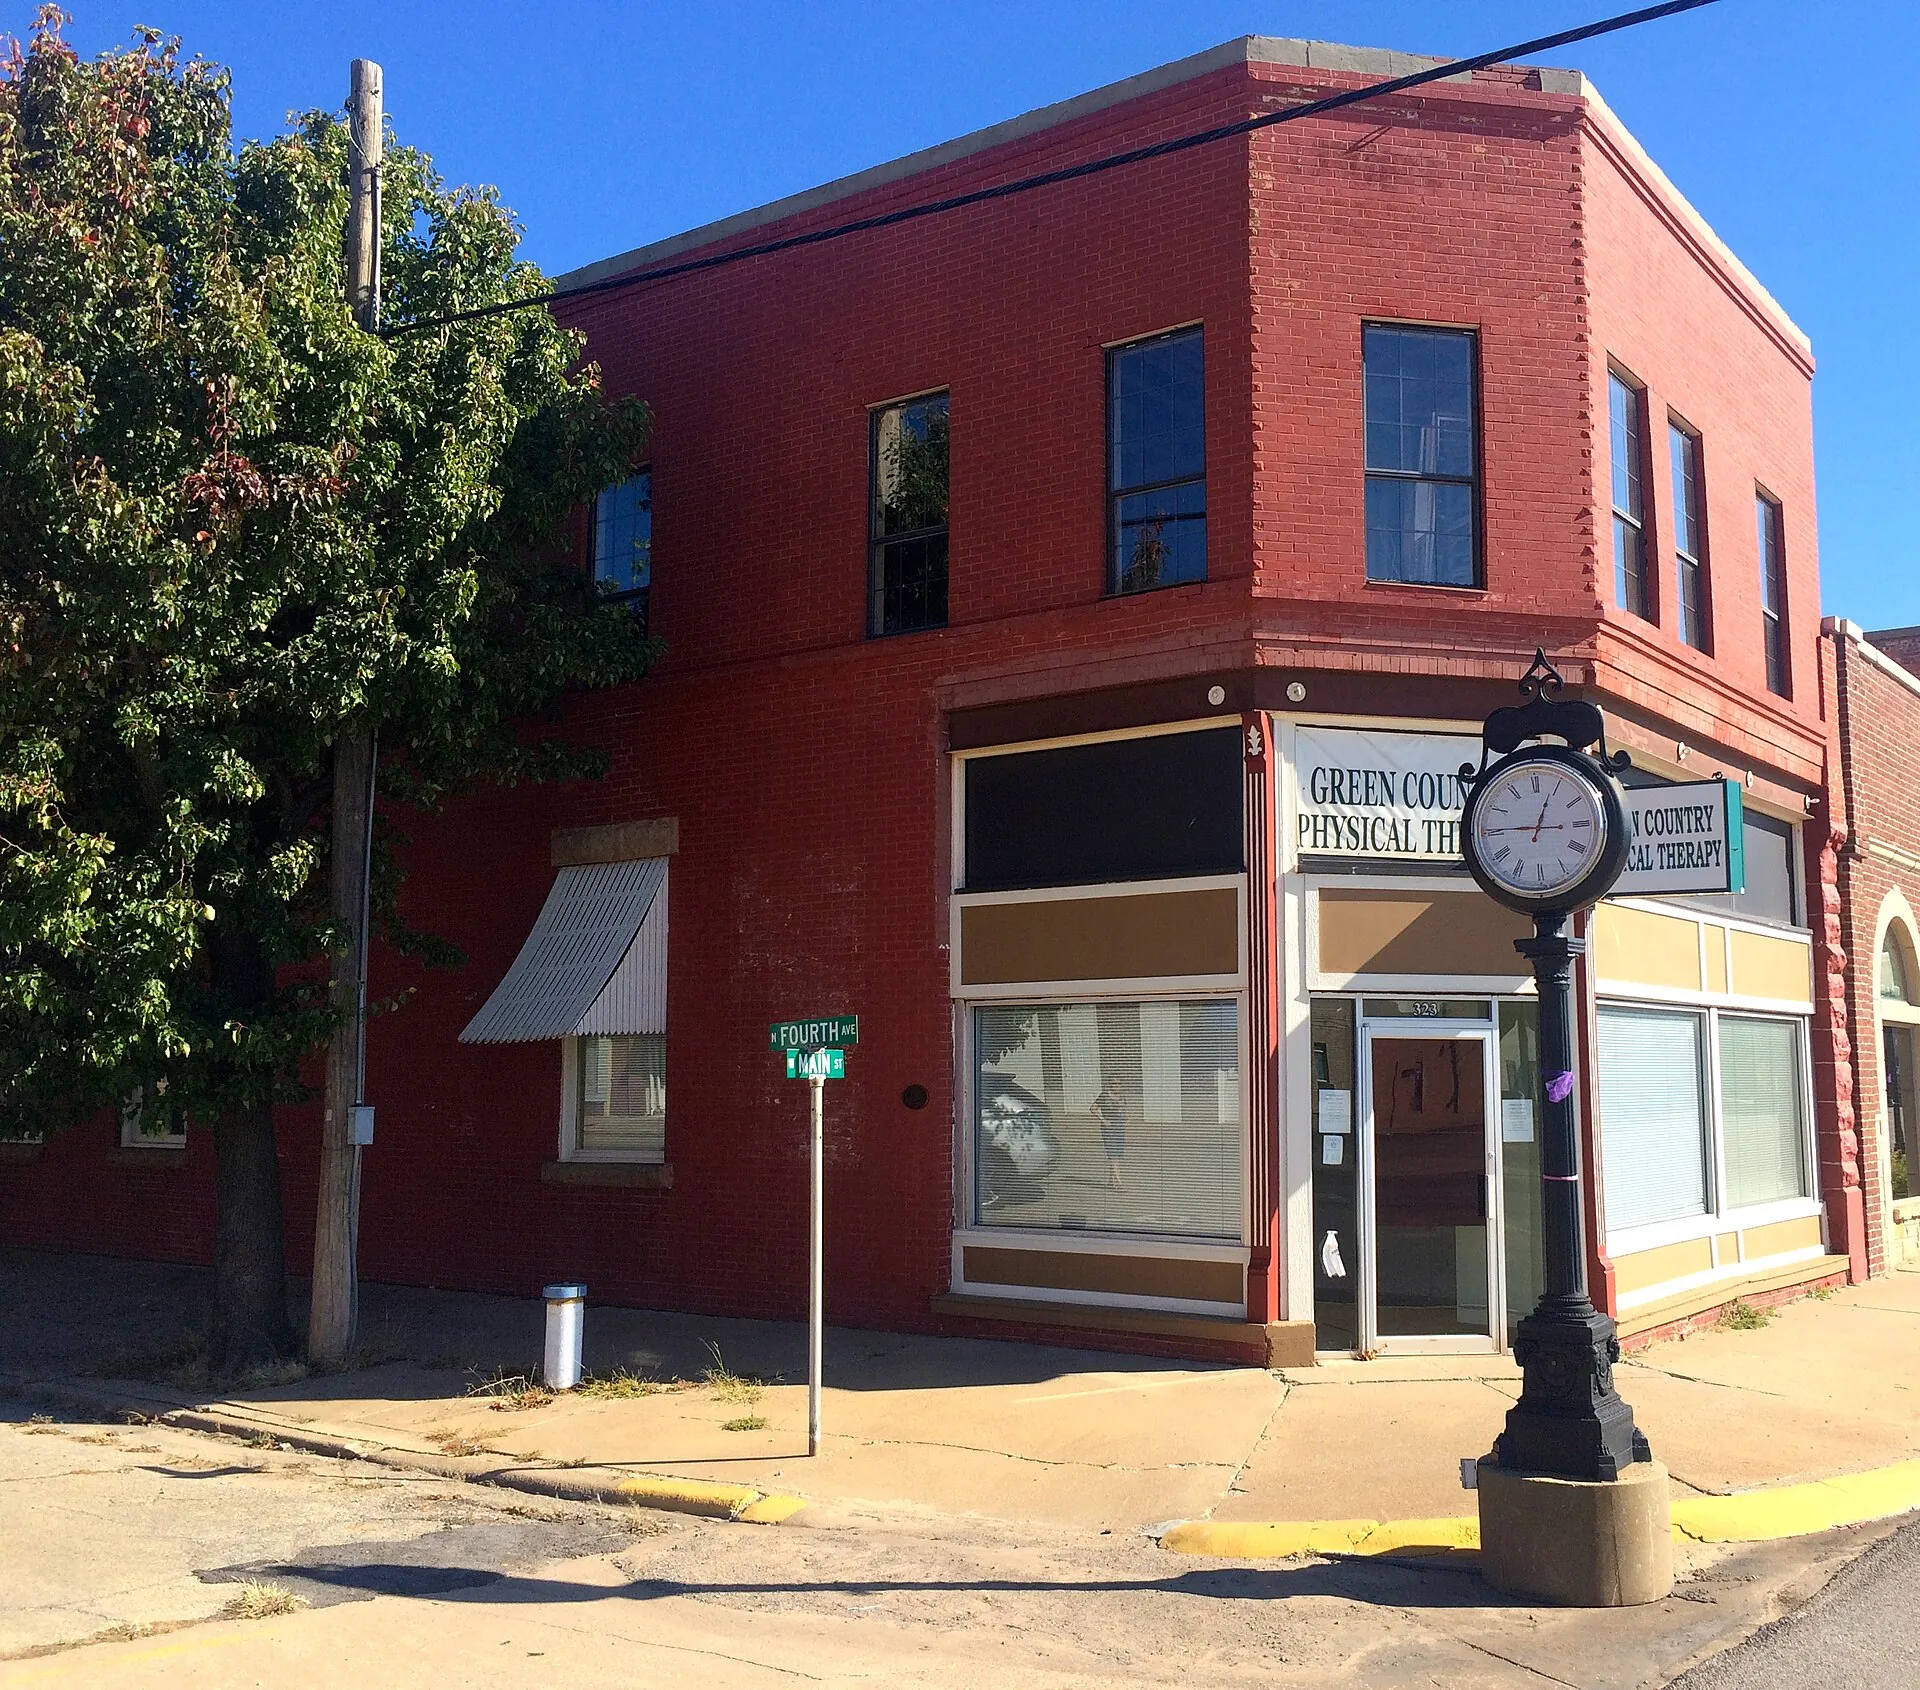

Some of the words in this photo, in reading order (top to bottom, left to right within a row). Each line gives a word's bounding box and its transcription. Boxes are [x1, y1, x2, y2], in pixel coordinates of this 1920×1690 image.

[1310, 766, 1397, 807] GREEN
[1403, 771, 1470, 810] COUN
[1298, 813, 1417, 853] PHYSICAL
[1631, 810, 1640, 837] N
[1644, 804, 1714, 837] COUNTRY
[1624, 844, 1654, 872] CAL
[1657, 840, 1722, 870] THERAPY
[1413, 1002, 1438, 1016] 323
[771, 1032, 777, 1043] N
[780, 1021, 839, 1046] FOURTH
[841, 1024, 856, 1036] AVE
[798, 1053, 831, 1074] MAIN
[834, 1058, 843, 1070] ST
